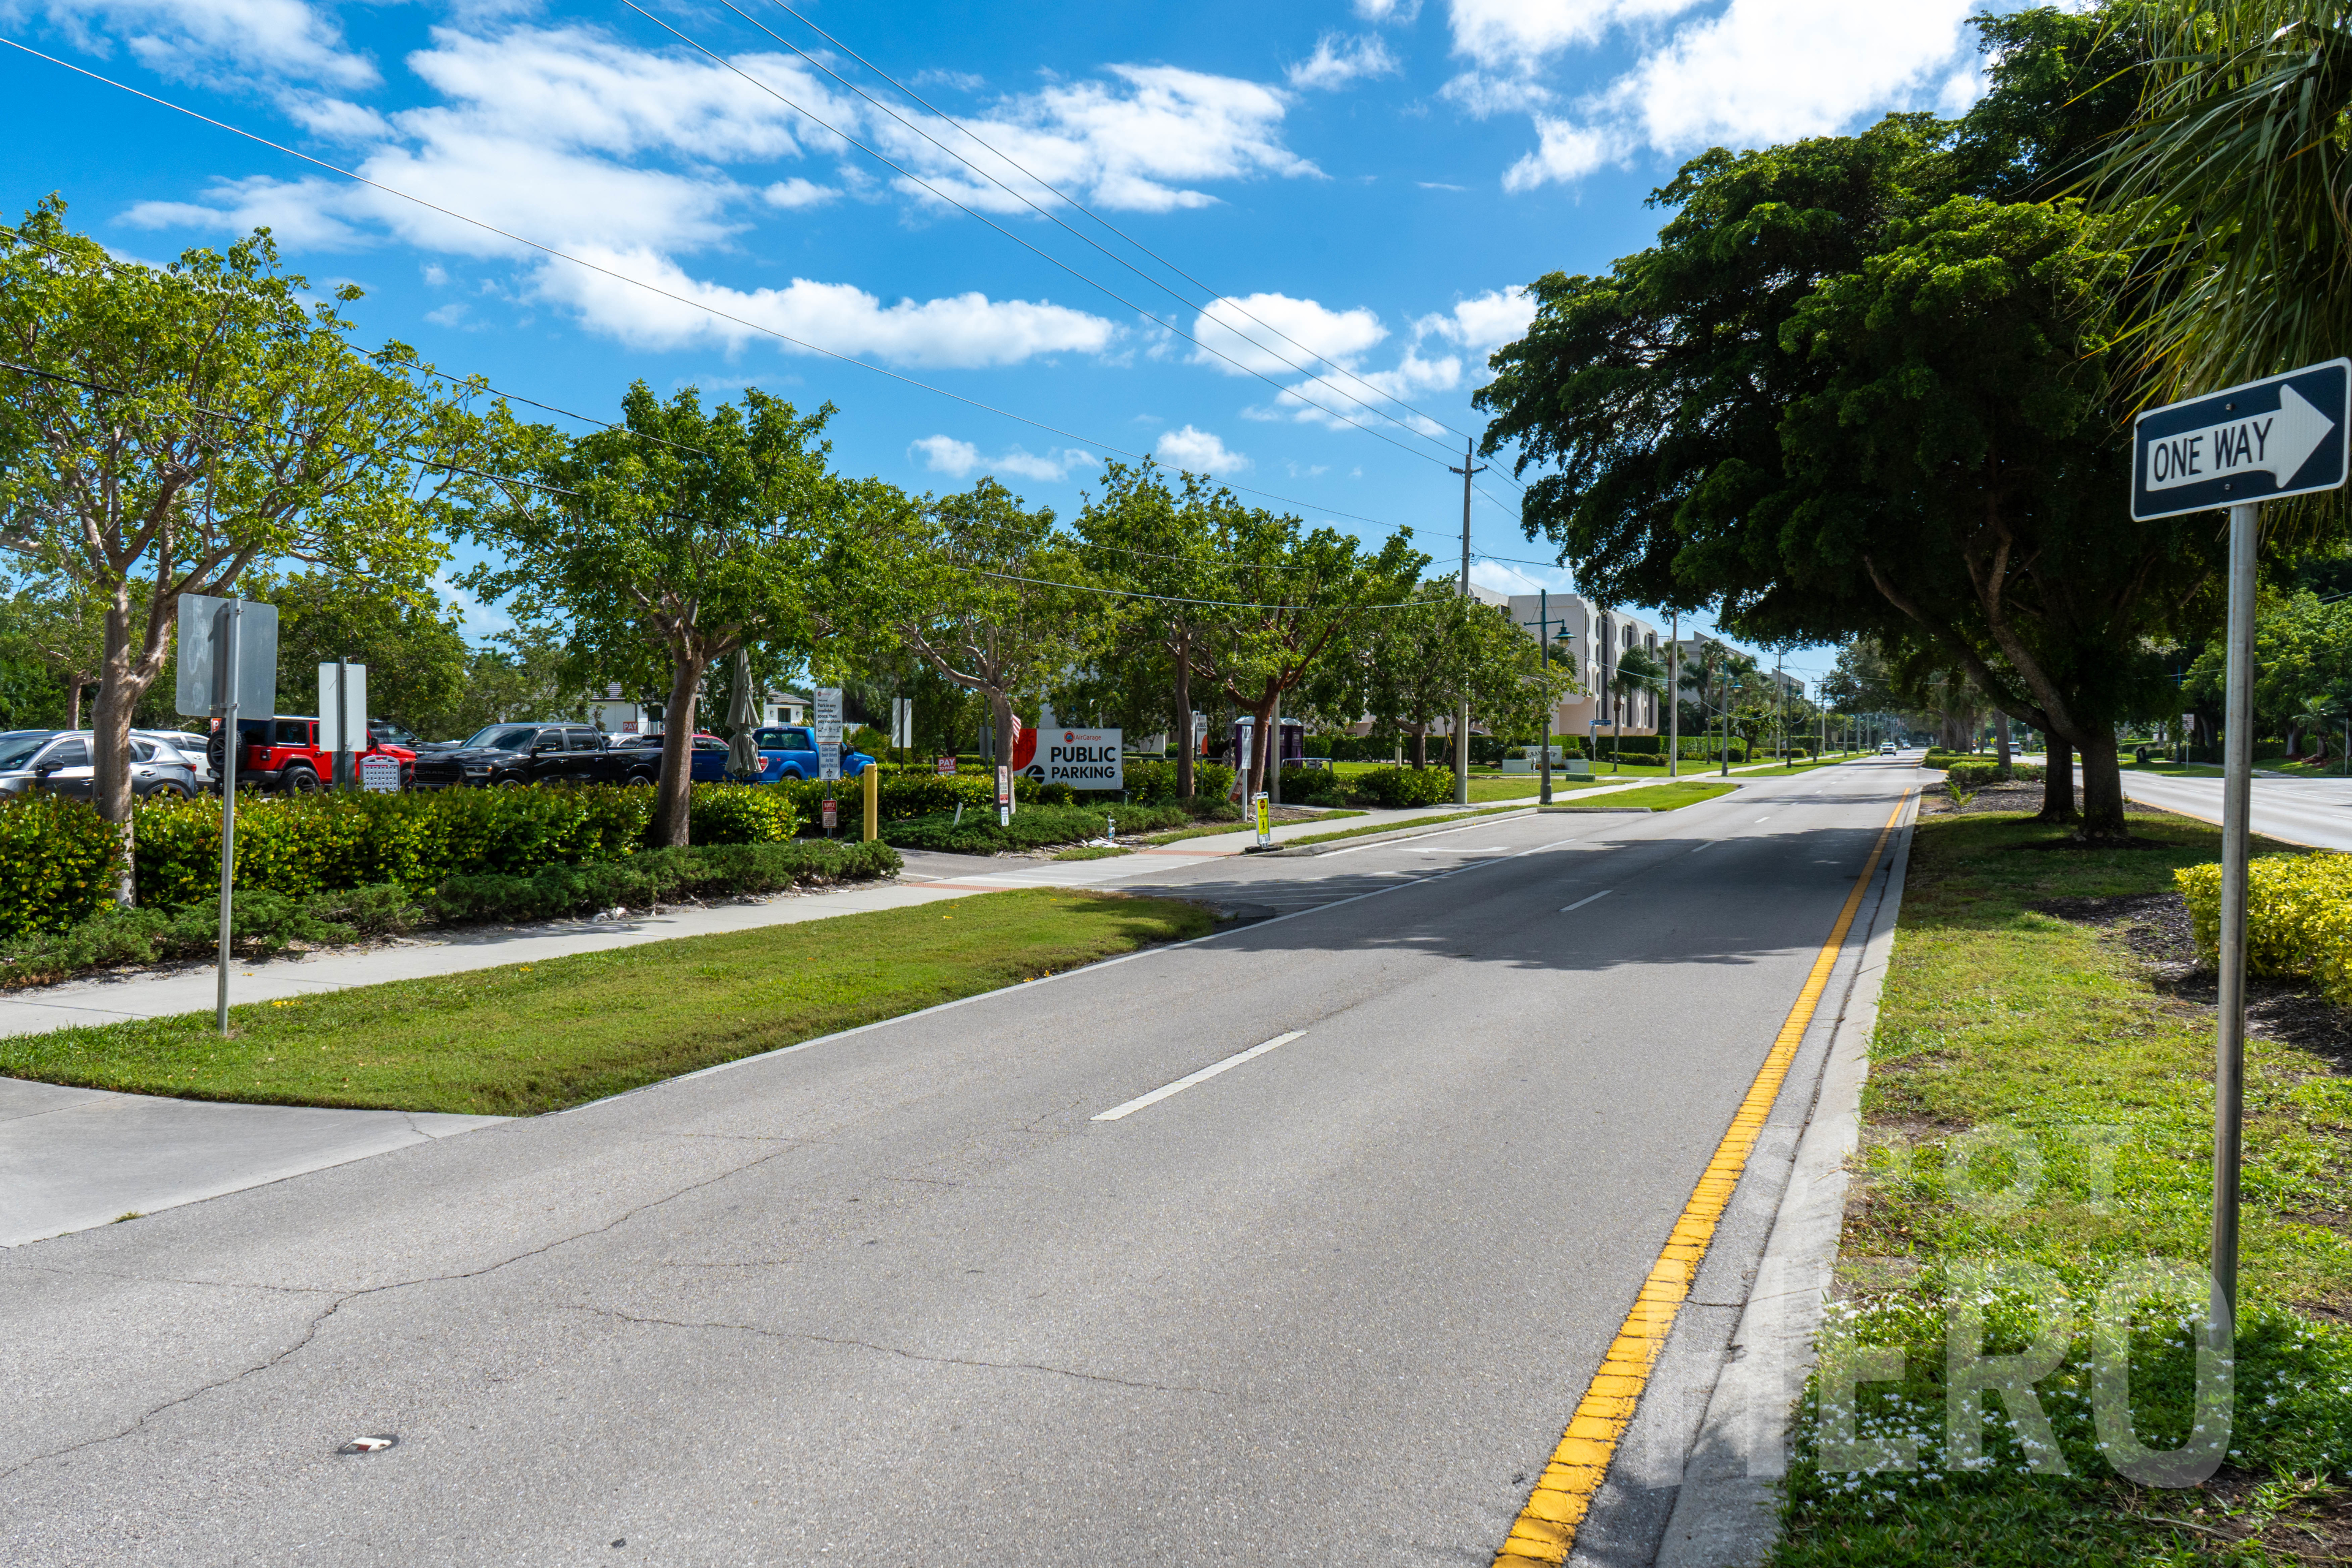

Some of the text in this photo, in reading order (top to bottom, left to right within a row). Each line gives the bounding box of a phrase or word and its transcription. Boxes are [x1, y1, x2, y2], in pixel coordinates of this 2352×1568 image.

[2154, 418, 2274, 483] ONE WAY
[1050, 747, 1116, 763] PUBLIC
[1051, 766, 1115, 778] PARKING
